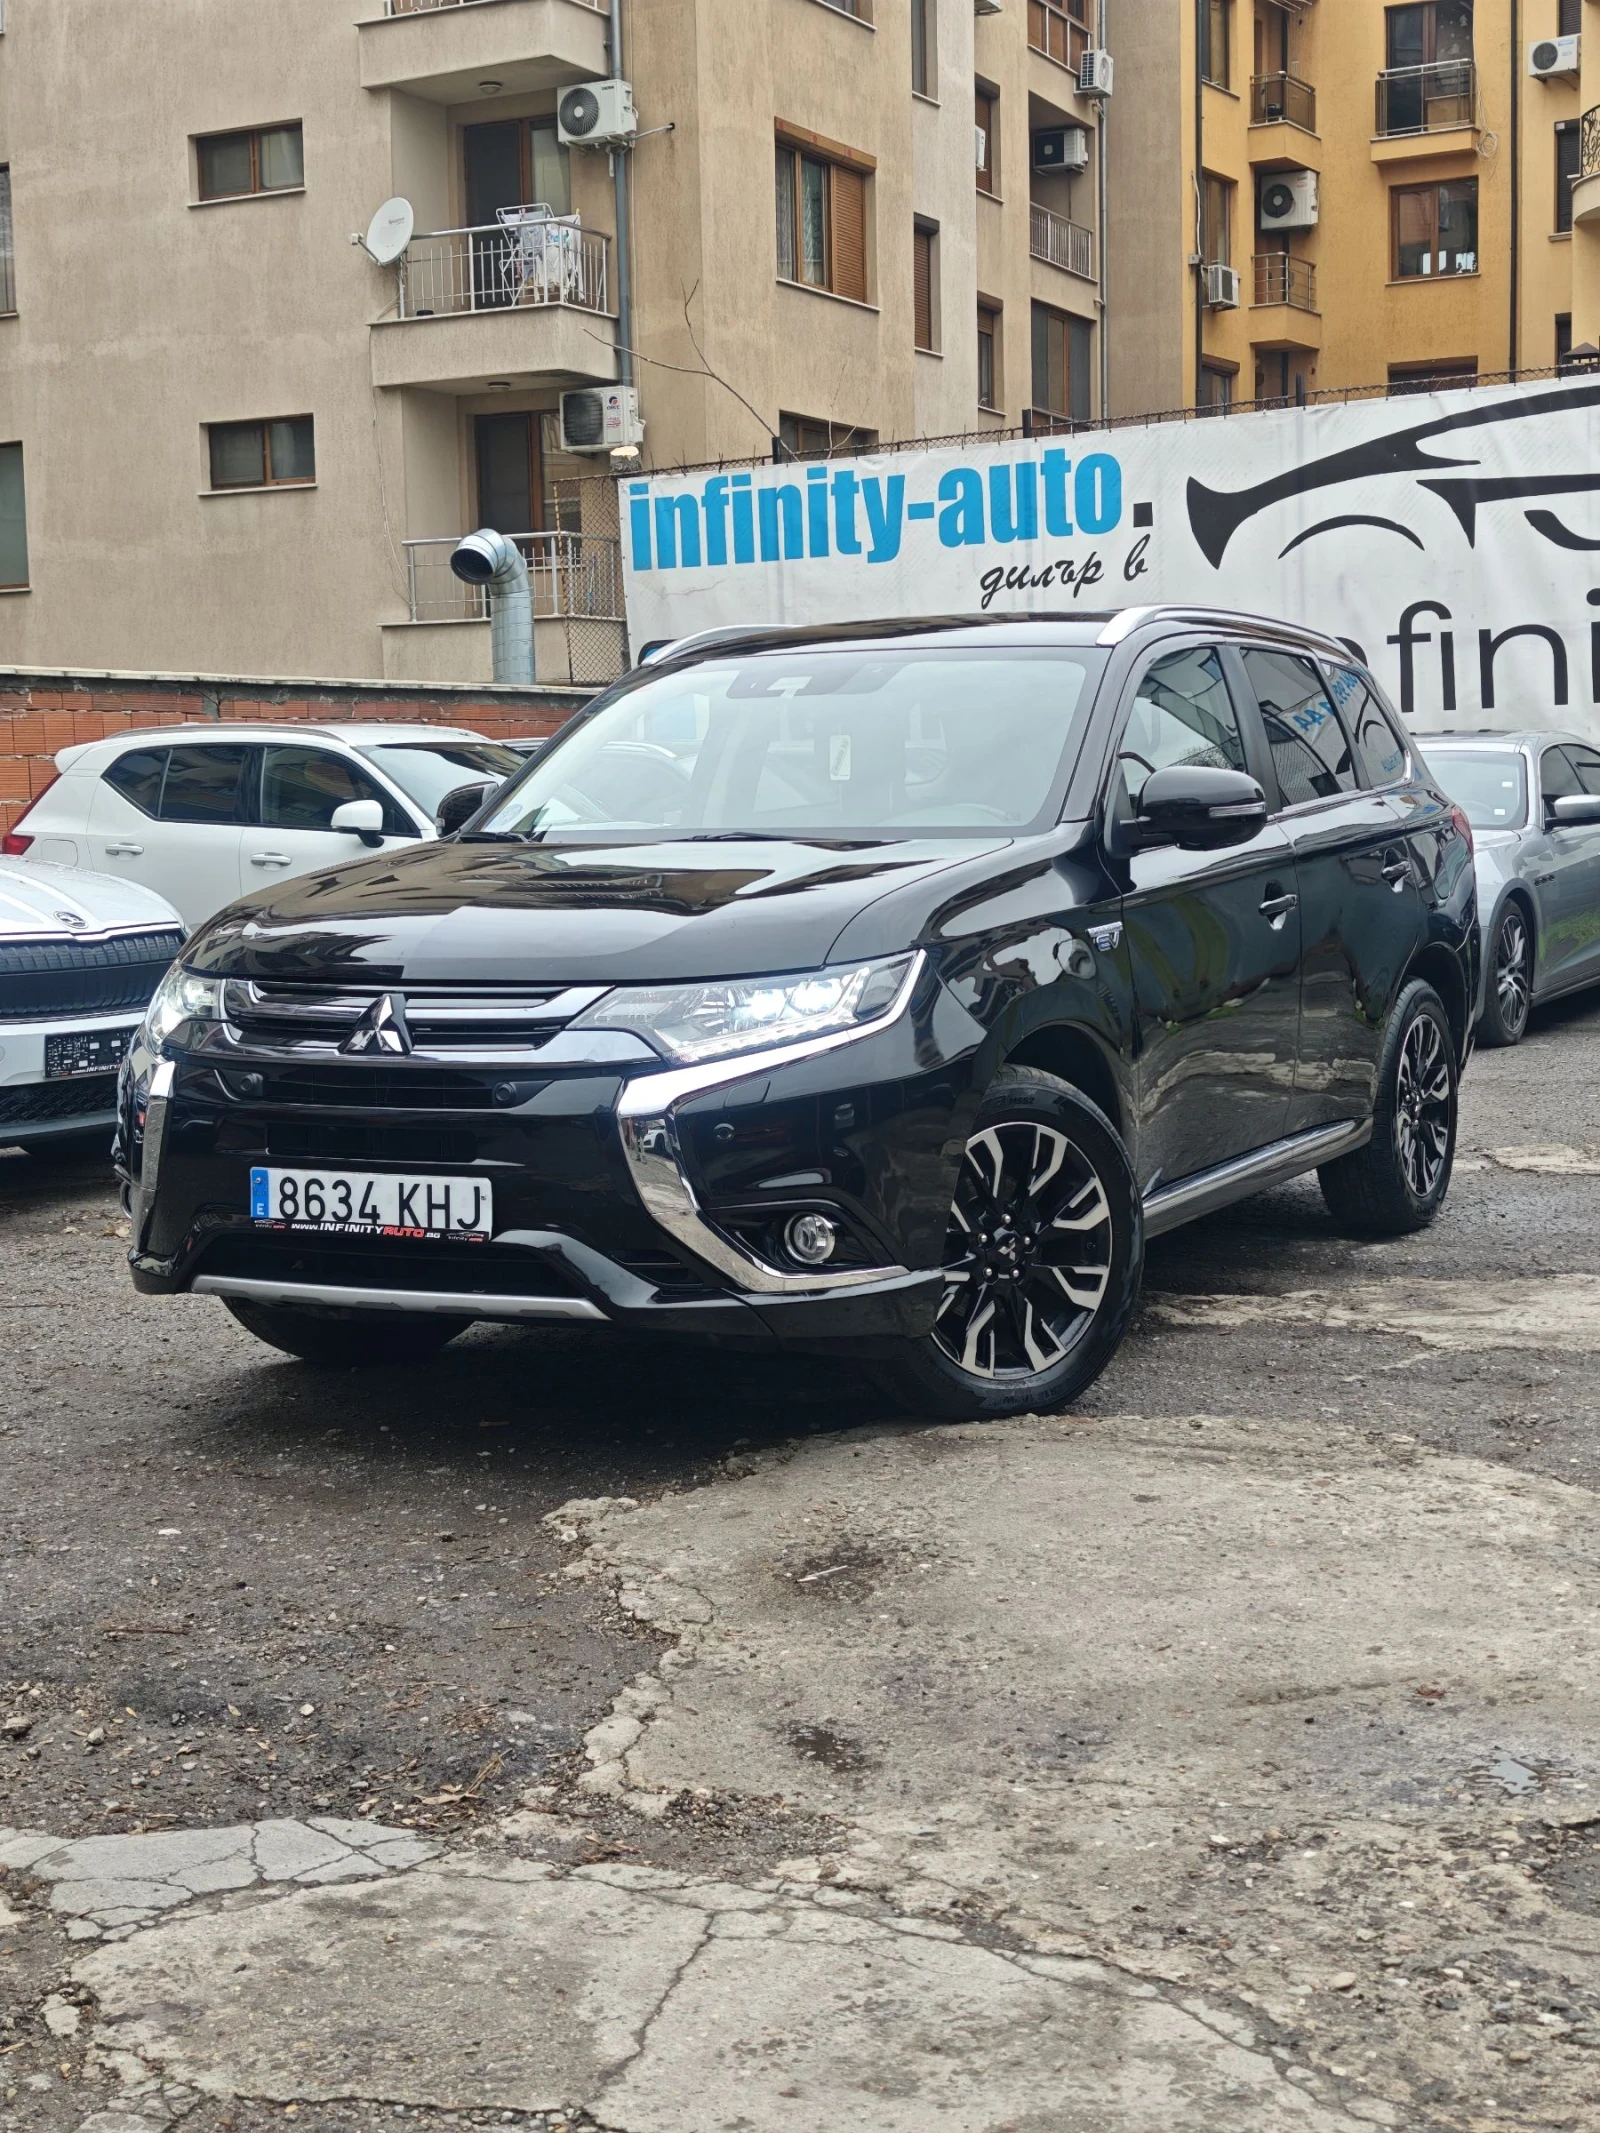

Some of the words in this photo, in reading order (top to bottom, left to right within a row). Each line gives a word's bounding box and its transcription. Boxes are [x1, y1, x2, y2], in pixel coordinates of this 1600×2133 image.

[980, 551, 1104, 609] дилър
[1123, 534, 1151, 581] в
[256, 1203, 265, 1216] E
[279, 1176, 381, 1223] 8634
[398, 1182, 481, 1230] KHJ
